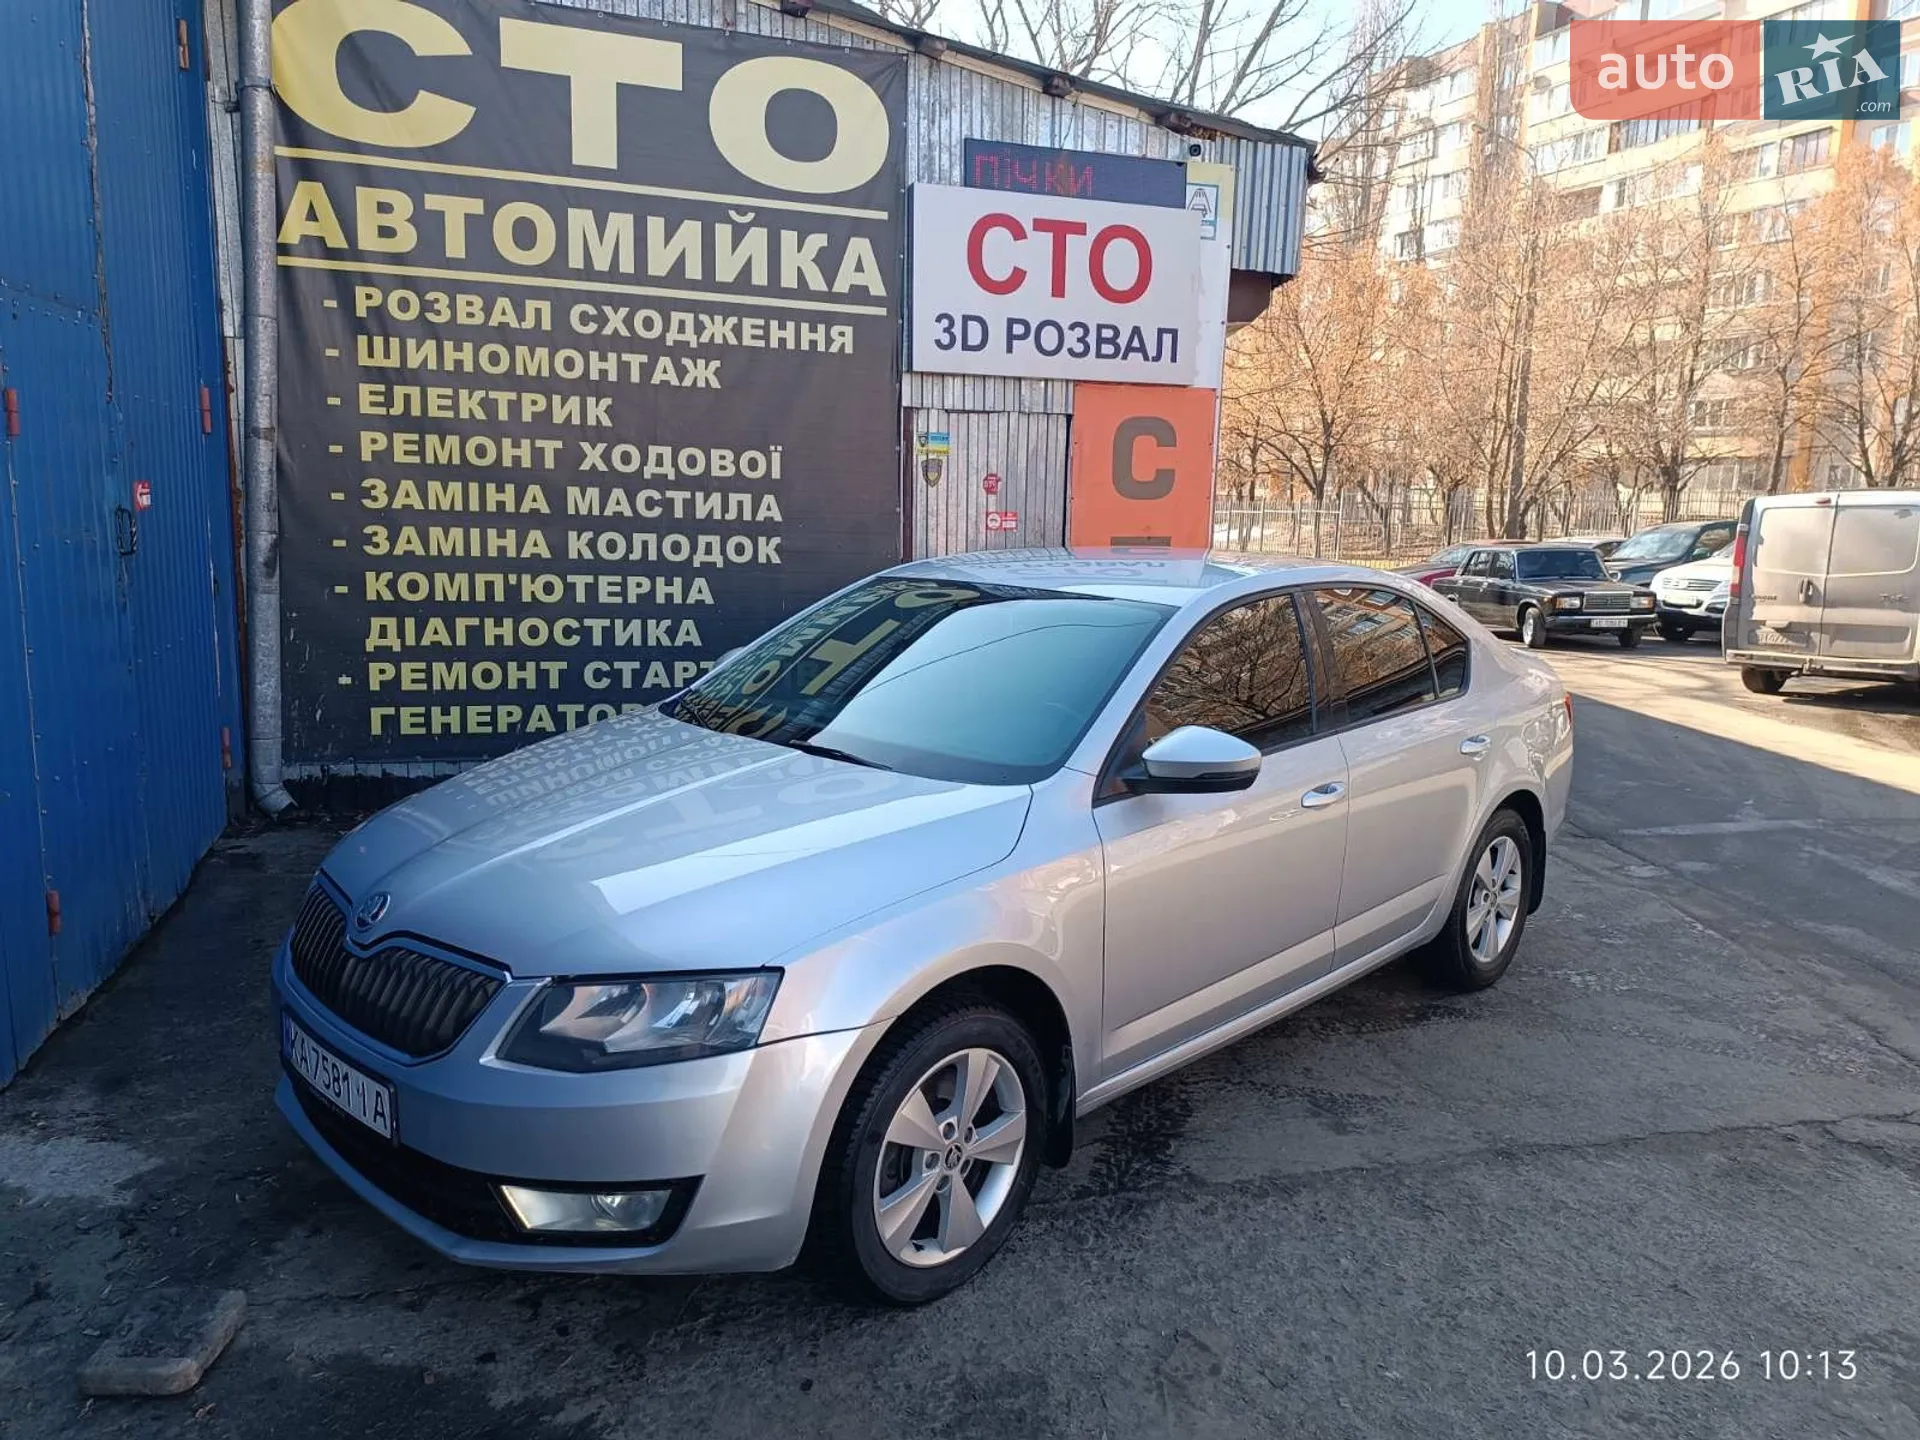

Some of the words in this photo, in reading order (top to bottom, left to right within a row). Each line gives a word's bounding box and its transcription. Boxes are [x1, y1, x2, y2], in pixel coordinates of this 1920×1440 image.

[270, 0, 890, 194] СТО
[277, 182, 887, 297] АВТОМИЙКА
[967, 212, 1153, 304] СТО
[355, 286, 552, 331] РОЗВАЛ
[570, 303, 853, 354] СХОДЖЕННЯ
[934, 313, 989, 352] 3D
[1006, 318, 1179, 363] РОЗВАЛ
[357, 335, 721, 389] ШИНОМОНТАЖ
[359, 383, 613, 427] ЕЛЕКТРИК
[360, 431, 563, 469] РЕМОНТ
[578, 440, 782, 481] ХОДОВОЇ
[361, 478, 550, 514] ЗАМІНА
[566, 486, 783, 523] МАСТИЛА
[362, 525, 551, 559] ЗАМІНА
[567, 530, 781, 567] КОЛОДОК
[365, 571, 715, 605] КОМП'ЮТЕРНА
[366, 617, 703, 652] ДІАГНОСТИКА
[368, 660, 568, 690] РЕМОНТ
